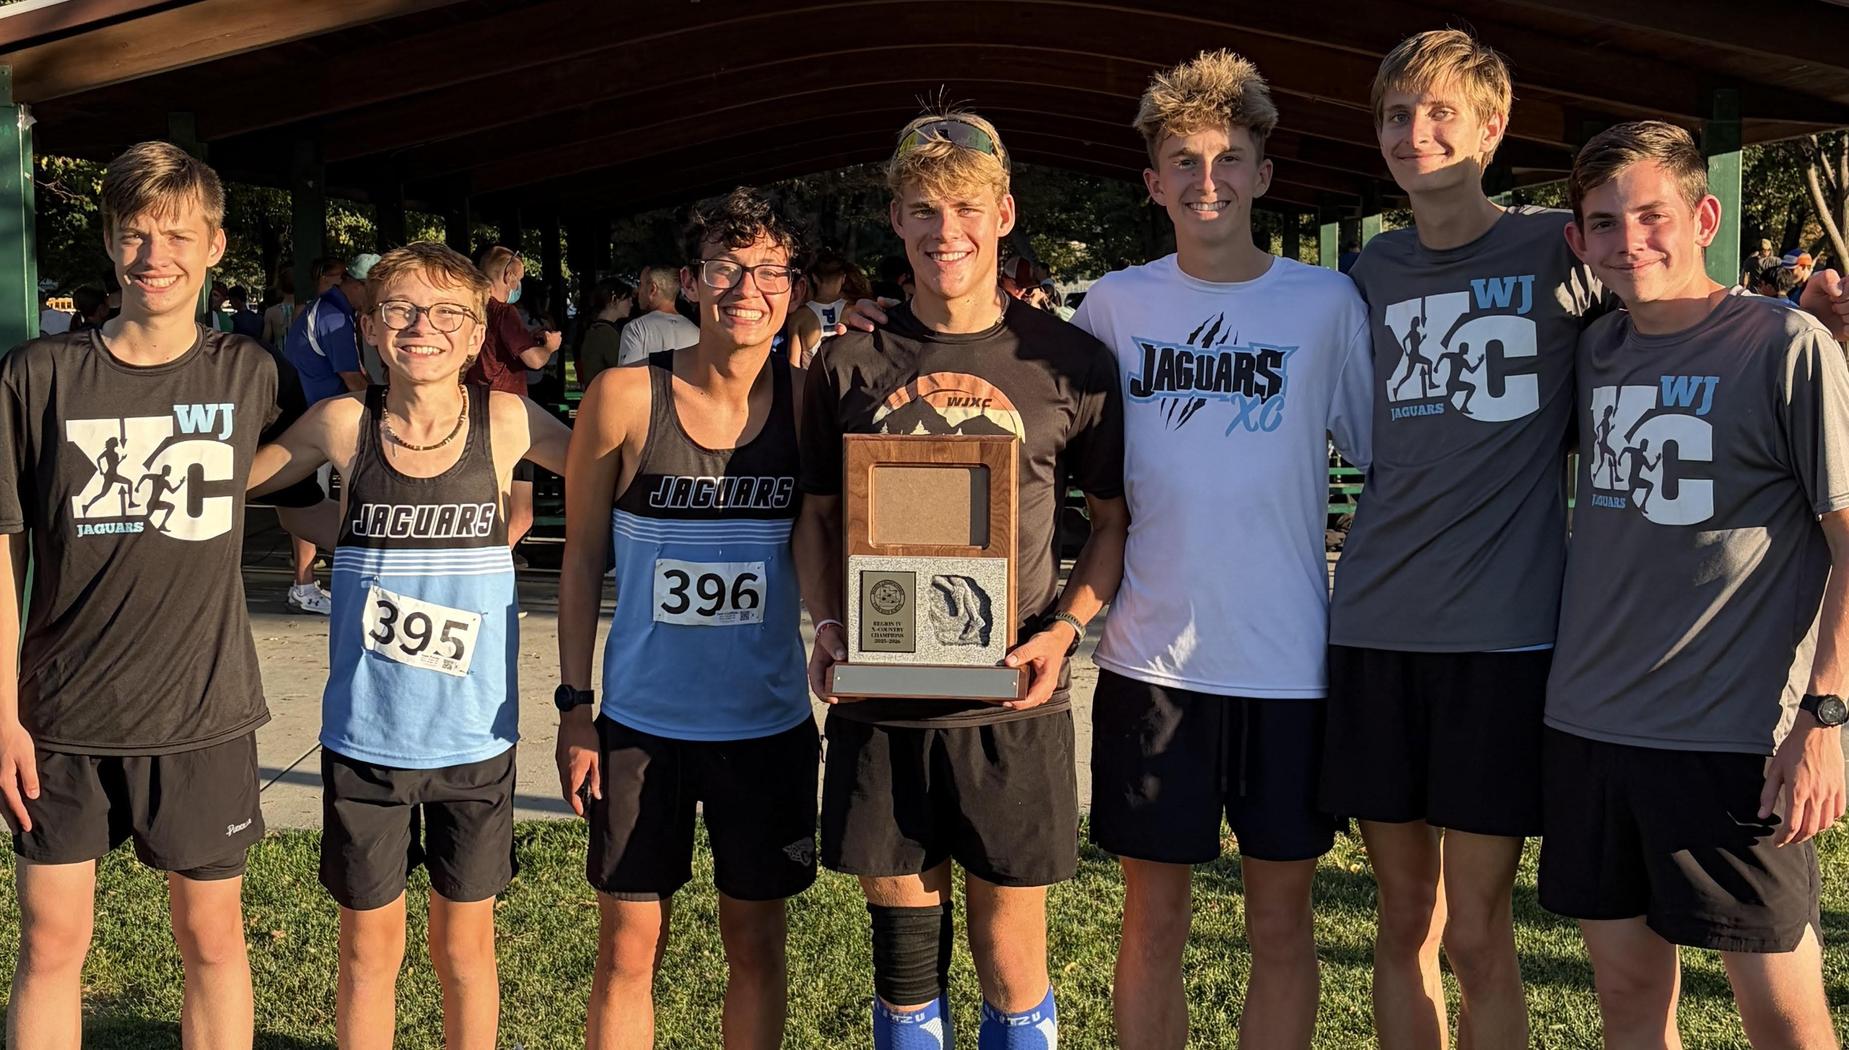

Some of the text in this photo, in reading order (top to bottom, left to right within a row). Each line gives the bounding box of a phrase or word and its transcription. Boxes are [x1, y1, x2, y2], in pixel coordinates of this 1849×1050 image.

[1471, 275, 1535, 314] WJ
[1130, 342, 1285, 404] JAGUARS
[1384, 291, 1540, 422] XC
[947, 396, 993, 408] WJXC
[1391, 403, 1445, 421] JAGUARS
[1660, 375, 1720, 415] WJ
[173, 403, 235, 440] WJ
[1226, 394, 1285, 437] XC
[1590, 385, 1714, 525] XC
[65, 415, 234, 541] XC
[650, 476, 794, 509] JAGUARS
[77, 521, 145, 538] JAGUARS
[352, 502, 496, 539] JAGUARS
[660, 569, 760, 617] 396
[368, 599, 470, 661] 395
